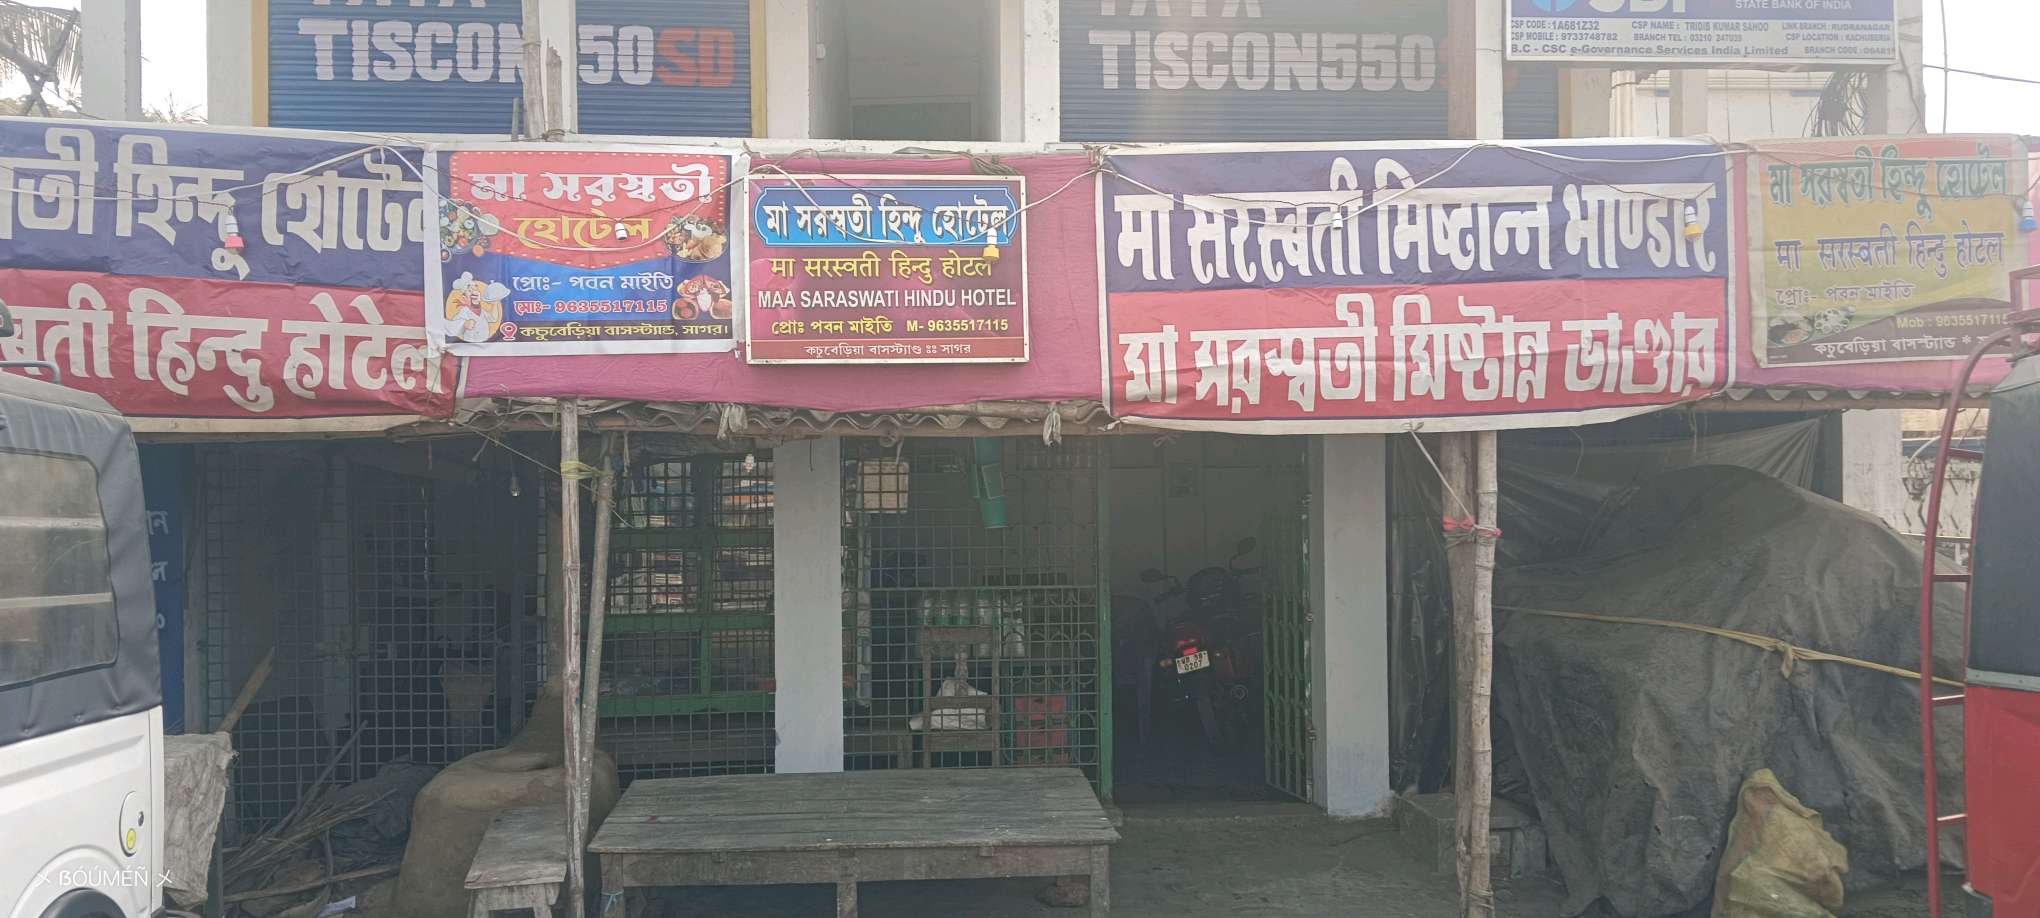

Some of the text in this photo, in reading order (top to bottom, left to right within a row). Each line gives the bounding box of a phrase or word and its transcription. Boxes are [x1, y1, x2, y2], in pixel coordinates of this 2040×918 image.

[1542, 44, 1566, 54] CSC
[1655, 45, 1708, 55] Services
[1712, 46, 1741, 55] India
[1744, 46, 1788, 56] Limited
[468, 163, 714, 206] মা সরস্বতী
[1767, 163, 1794, 206] মা
[513, 207, 653, 249] হোটেল
[762, 193, 1009, 243] মা সরস্বতী হিন্দু হোটেল
[1114, 193, 1175, 280] मा
[768, 250, 993, 285] मा सरस्वती हिन्दु होटल
[1775, 239, 1802, 272] मा
[569, 276, 614, 290] পবন
[620, 272, 674, 291] মাইতি
[758, 288, 1017, 308] MAA SARASWATI HINDU HOTEL
[554, 299, 668, 314] 9635517115
[810, 319, 843, 334] পবন
[848, 316, 893, 335] মাইতি
[927, 319, 1009, 332] 9635517115
[941, 343, 972, 355] সাগর
[1118, 325, 1178, 404] মা
[1190, 293, 1378, 413] সরস্বতী
